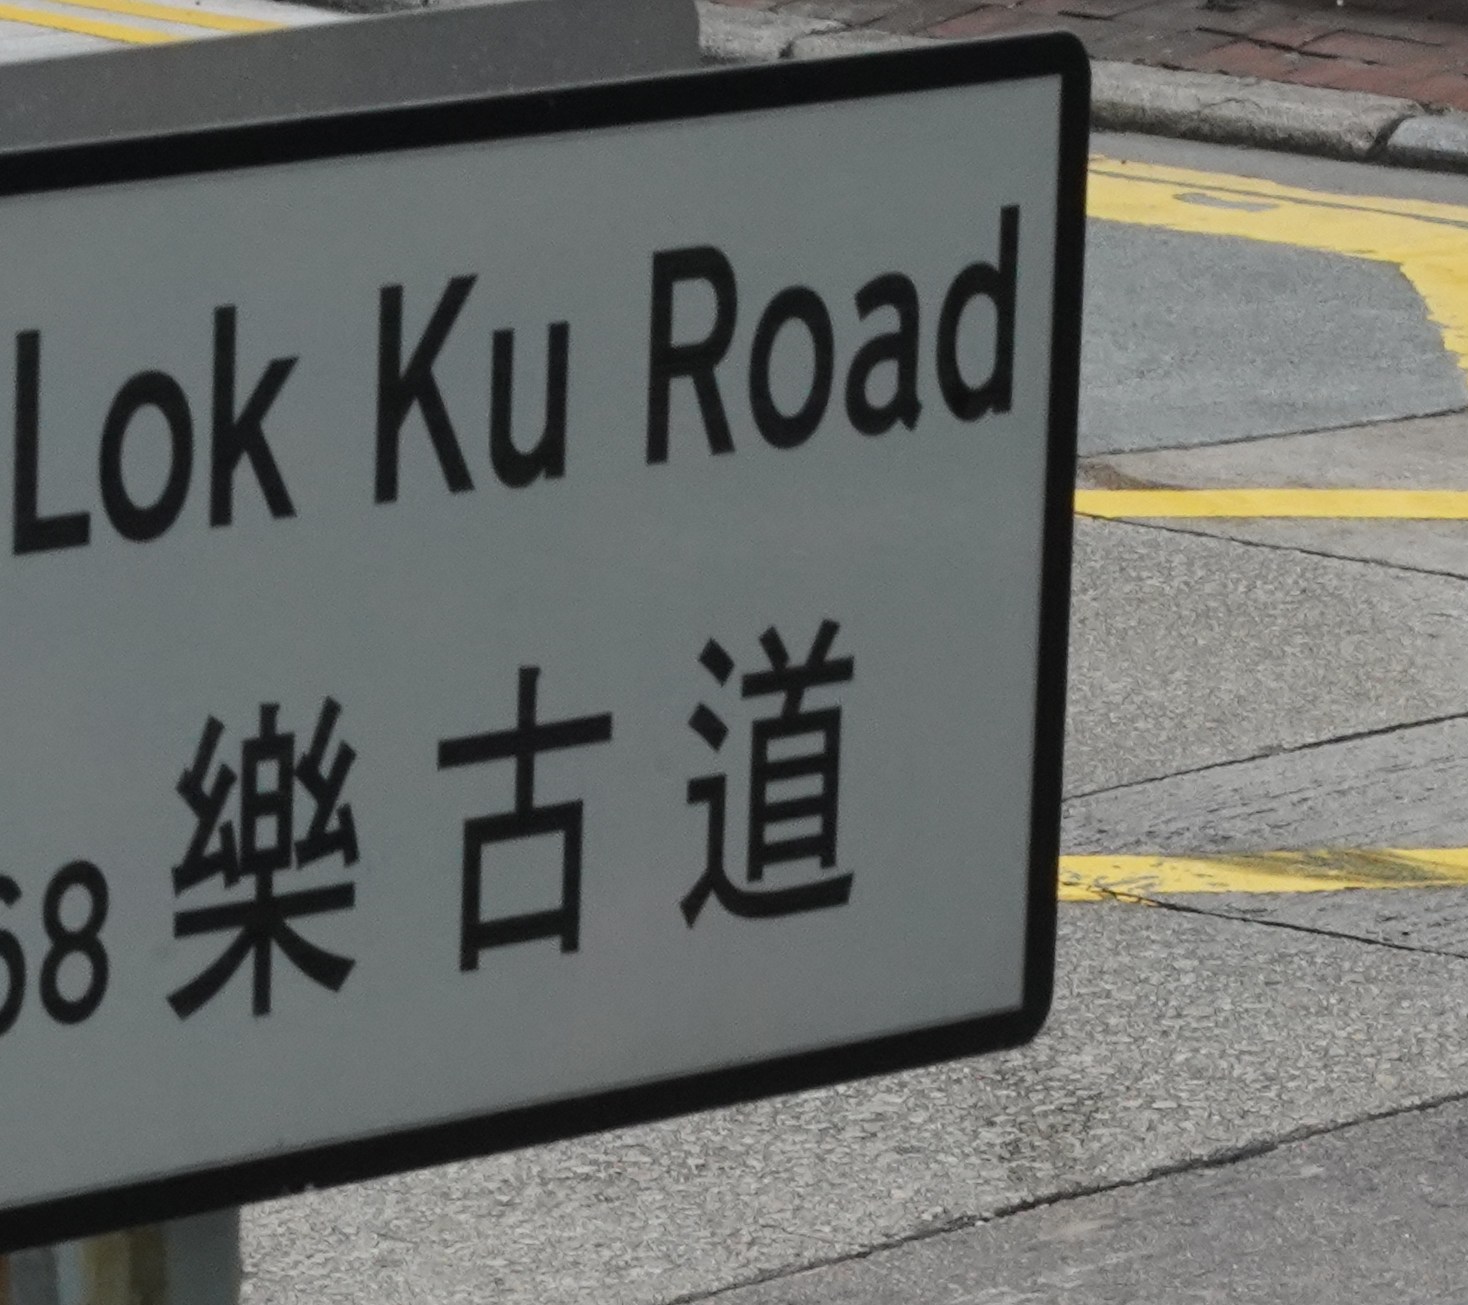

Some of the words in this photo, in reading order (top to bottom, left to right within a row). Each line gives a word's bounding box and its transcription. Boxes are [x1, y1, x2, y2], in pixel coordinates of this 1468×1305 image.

[12, 305, 299, 556] Lok
[374, 274, 570, 505] Ku
[646, 204, 1021, 466] Road
[166, 618, 856, 1019] 樂古道
